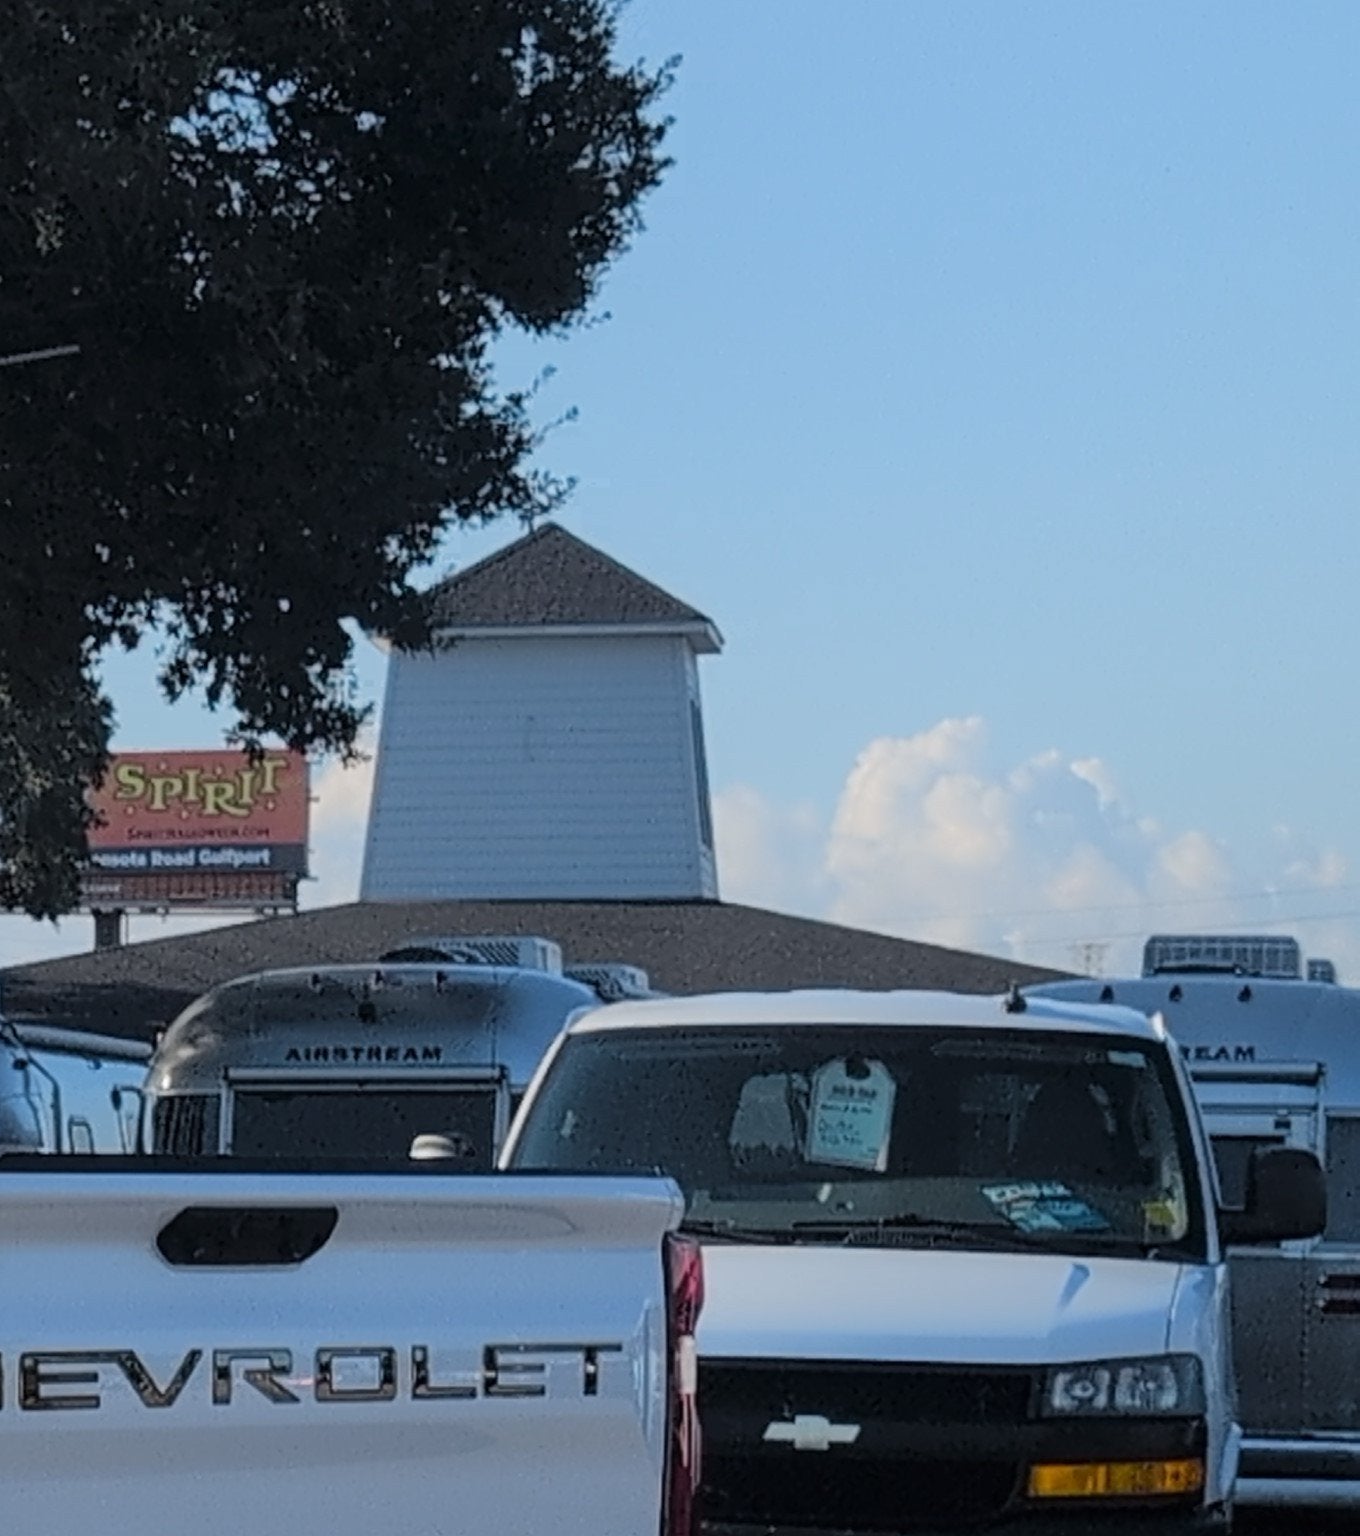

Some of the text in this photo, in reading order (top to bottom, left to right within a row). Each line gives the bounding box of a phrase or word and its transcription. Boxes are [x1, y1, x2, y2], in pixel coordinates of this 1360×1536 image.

[114, 758, 288, 818] SPIRIT
[150, 850, 195, 868] Road
[198, 849, 271, 869] Gulfport
[284, 1046, 443, 1064] AIRSTREAM
